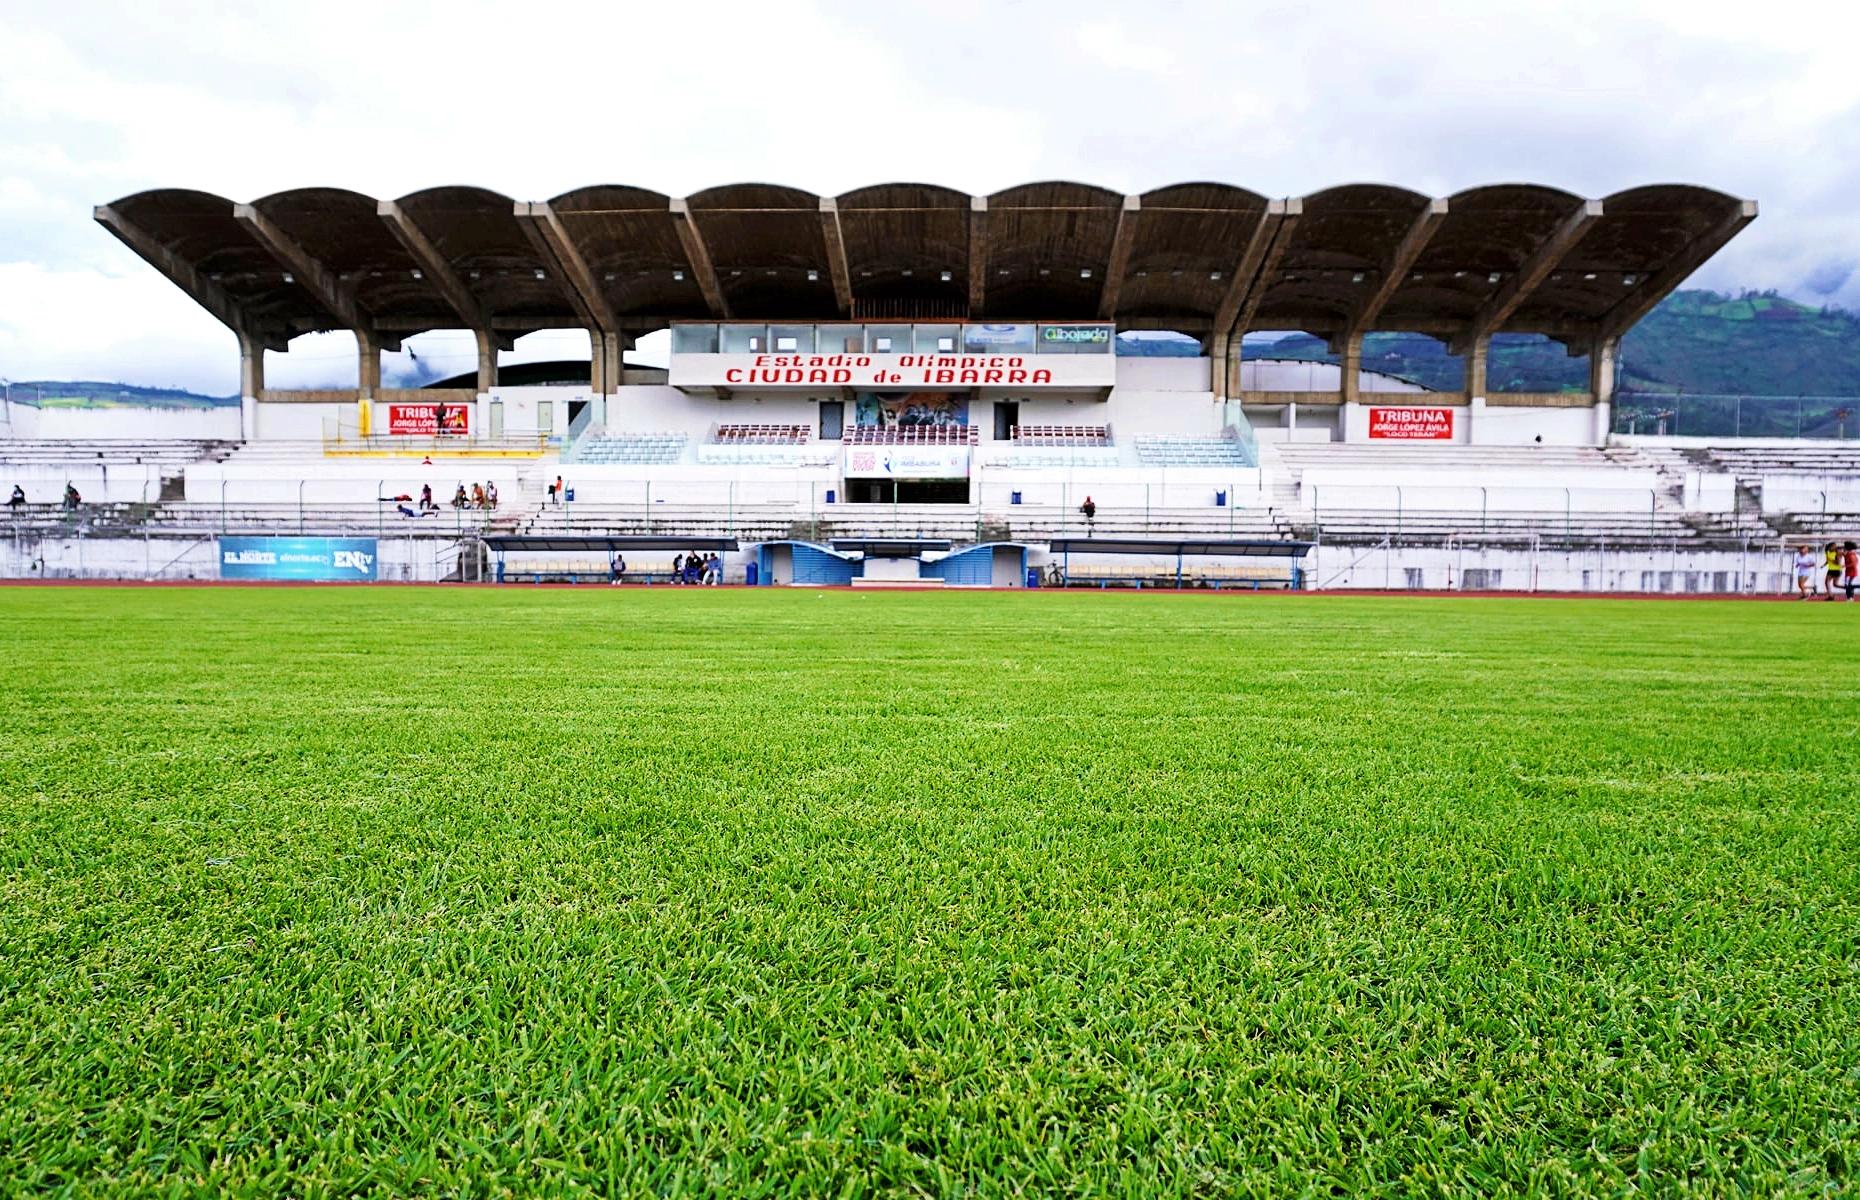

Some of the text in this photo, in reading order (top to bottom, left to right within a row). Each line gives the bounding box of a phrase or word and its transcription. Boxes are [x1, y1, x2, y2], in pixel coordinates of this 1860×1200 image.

[755, 354, 1024, 369] Estadio Olímpico
[726, 368, 1052, 384] CIUDAD de IBARRA
[393, 419, 417, 428] JORGE
[418, 418, 439, 428] LÓPE
[1377, 410, 1446, 423] TRIBUNA
[1373, 423, 1399, 432] JORGE
